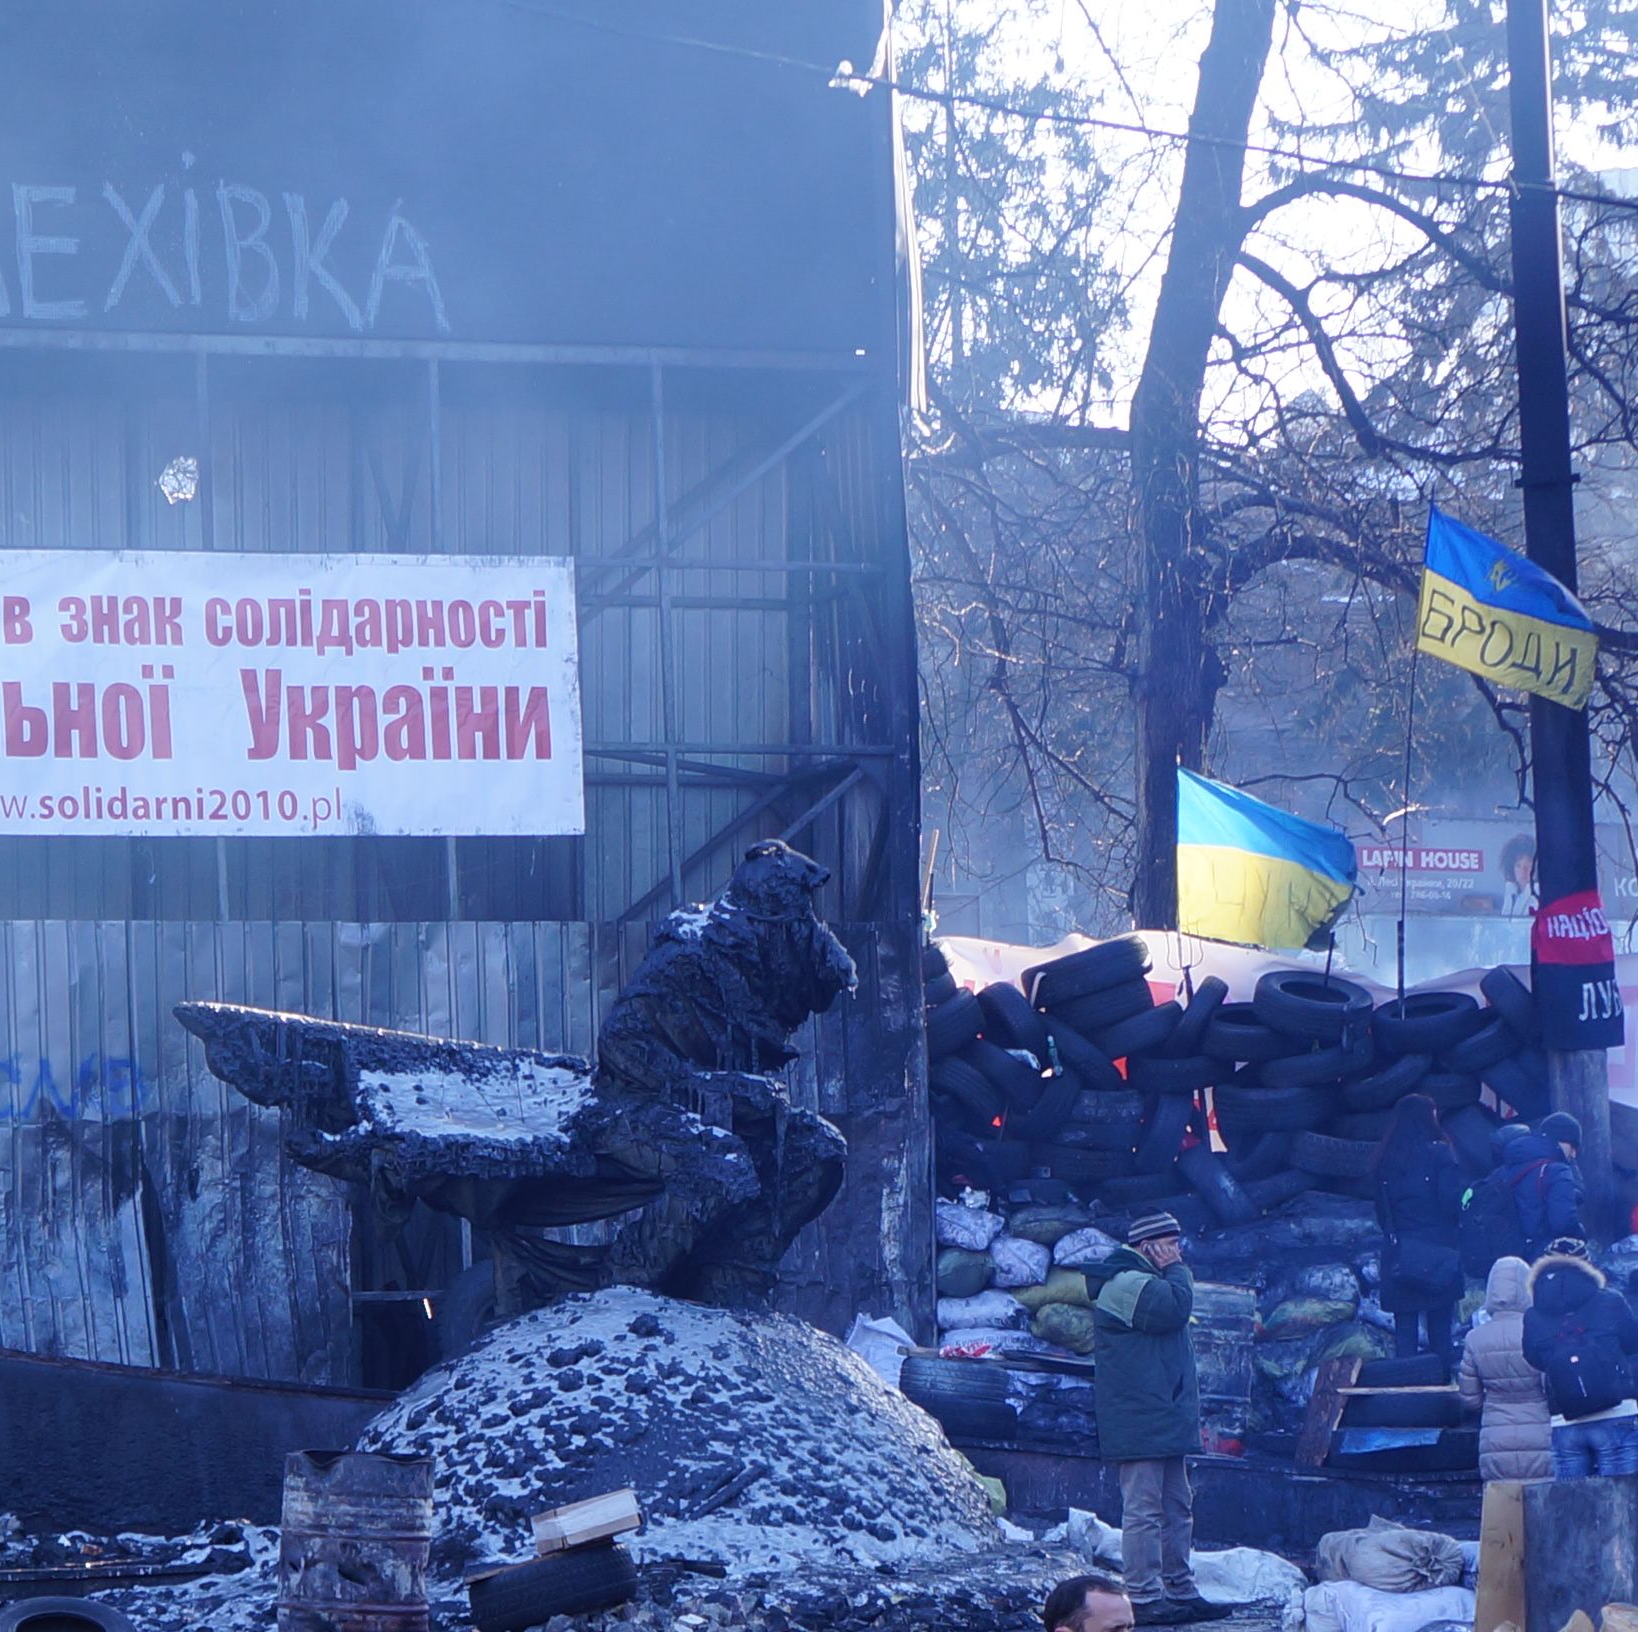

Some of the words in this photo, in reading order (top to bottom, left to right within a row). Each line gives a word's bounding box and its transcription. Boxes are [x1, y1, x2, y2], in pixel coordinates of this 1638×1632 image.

[2, 595, 34, 645] в
[59, 594, 184, 647] знак
[204, 587, 548, 657] солідарності
[1419, 592, 1580, 697] БРОДИ
[239, 665, 553, 772] України
[1420, 849, 1479, 870] HOUSE
[1447, 877, 1474, 889] 20/22
